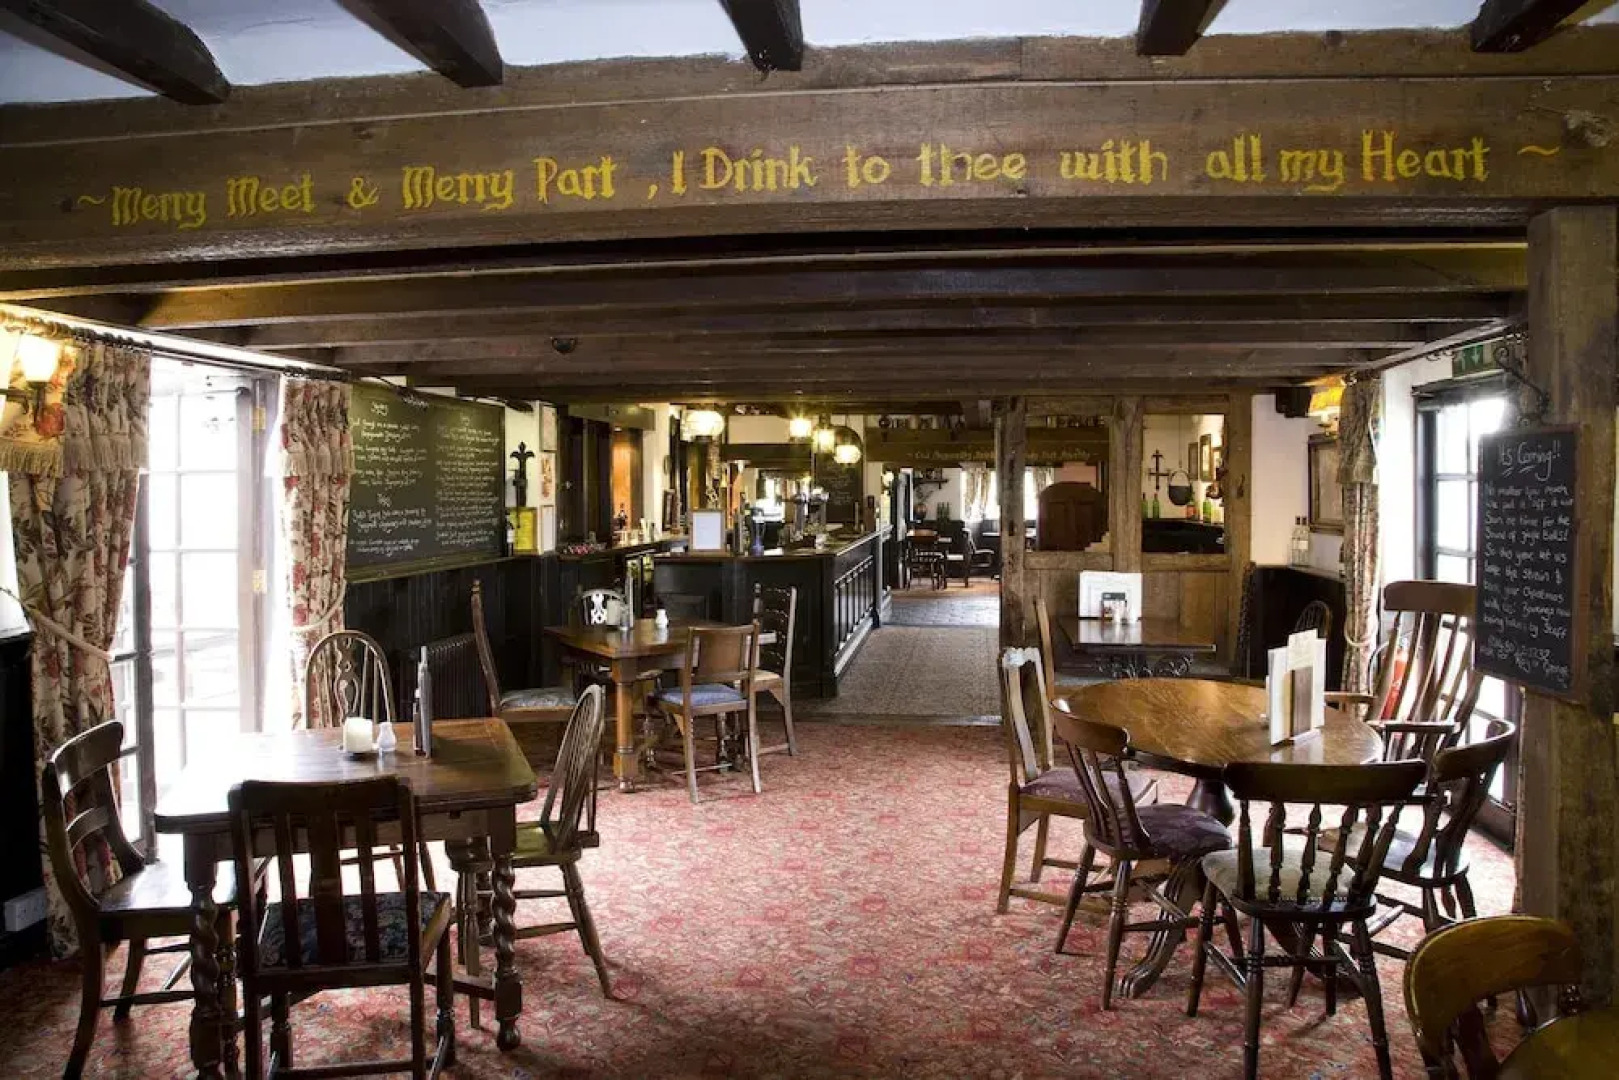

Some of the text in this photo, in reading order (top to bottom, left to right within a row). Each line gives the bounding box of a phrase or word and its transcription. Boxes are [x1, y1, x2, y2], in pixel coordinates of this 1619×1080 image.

[111, 185, 207, 230] Merry
[227, 170, 316, 218] Meet
[348, 176, 381, 208] &
[402, 165, 514, 213] Merry
[532, 156, 616, 205] Part
[700, 144, 818, 191] Drink
[842, 142, 892, 189] to
[915, 141, 1027, 188] thee
[1060, 138, 1168, 186] with
[1205, 132, 1267, 184] all
[1279, 149, 1346, 193] my
[1360, 128, 1491, 182] Heart
